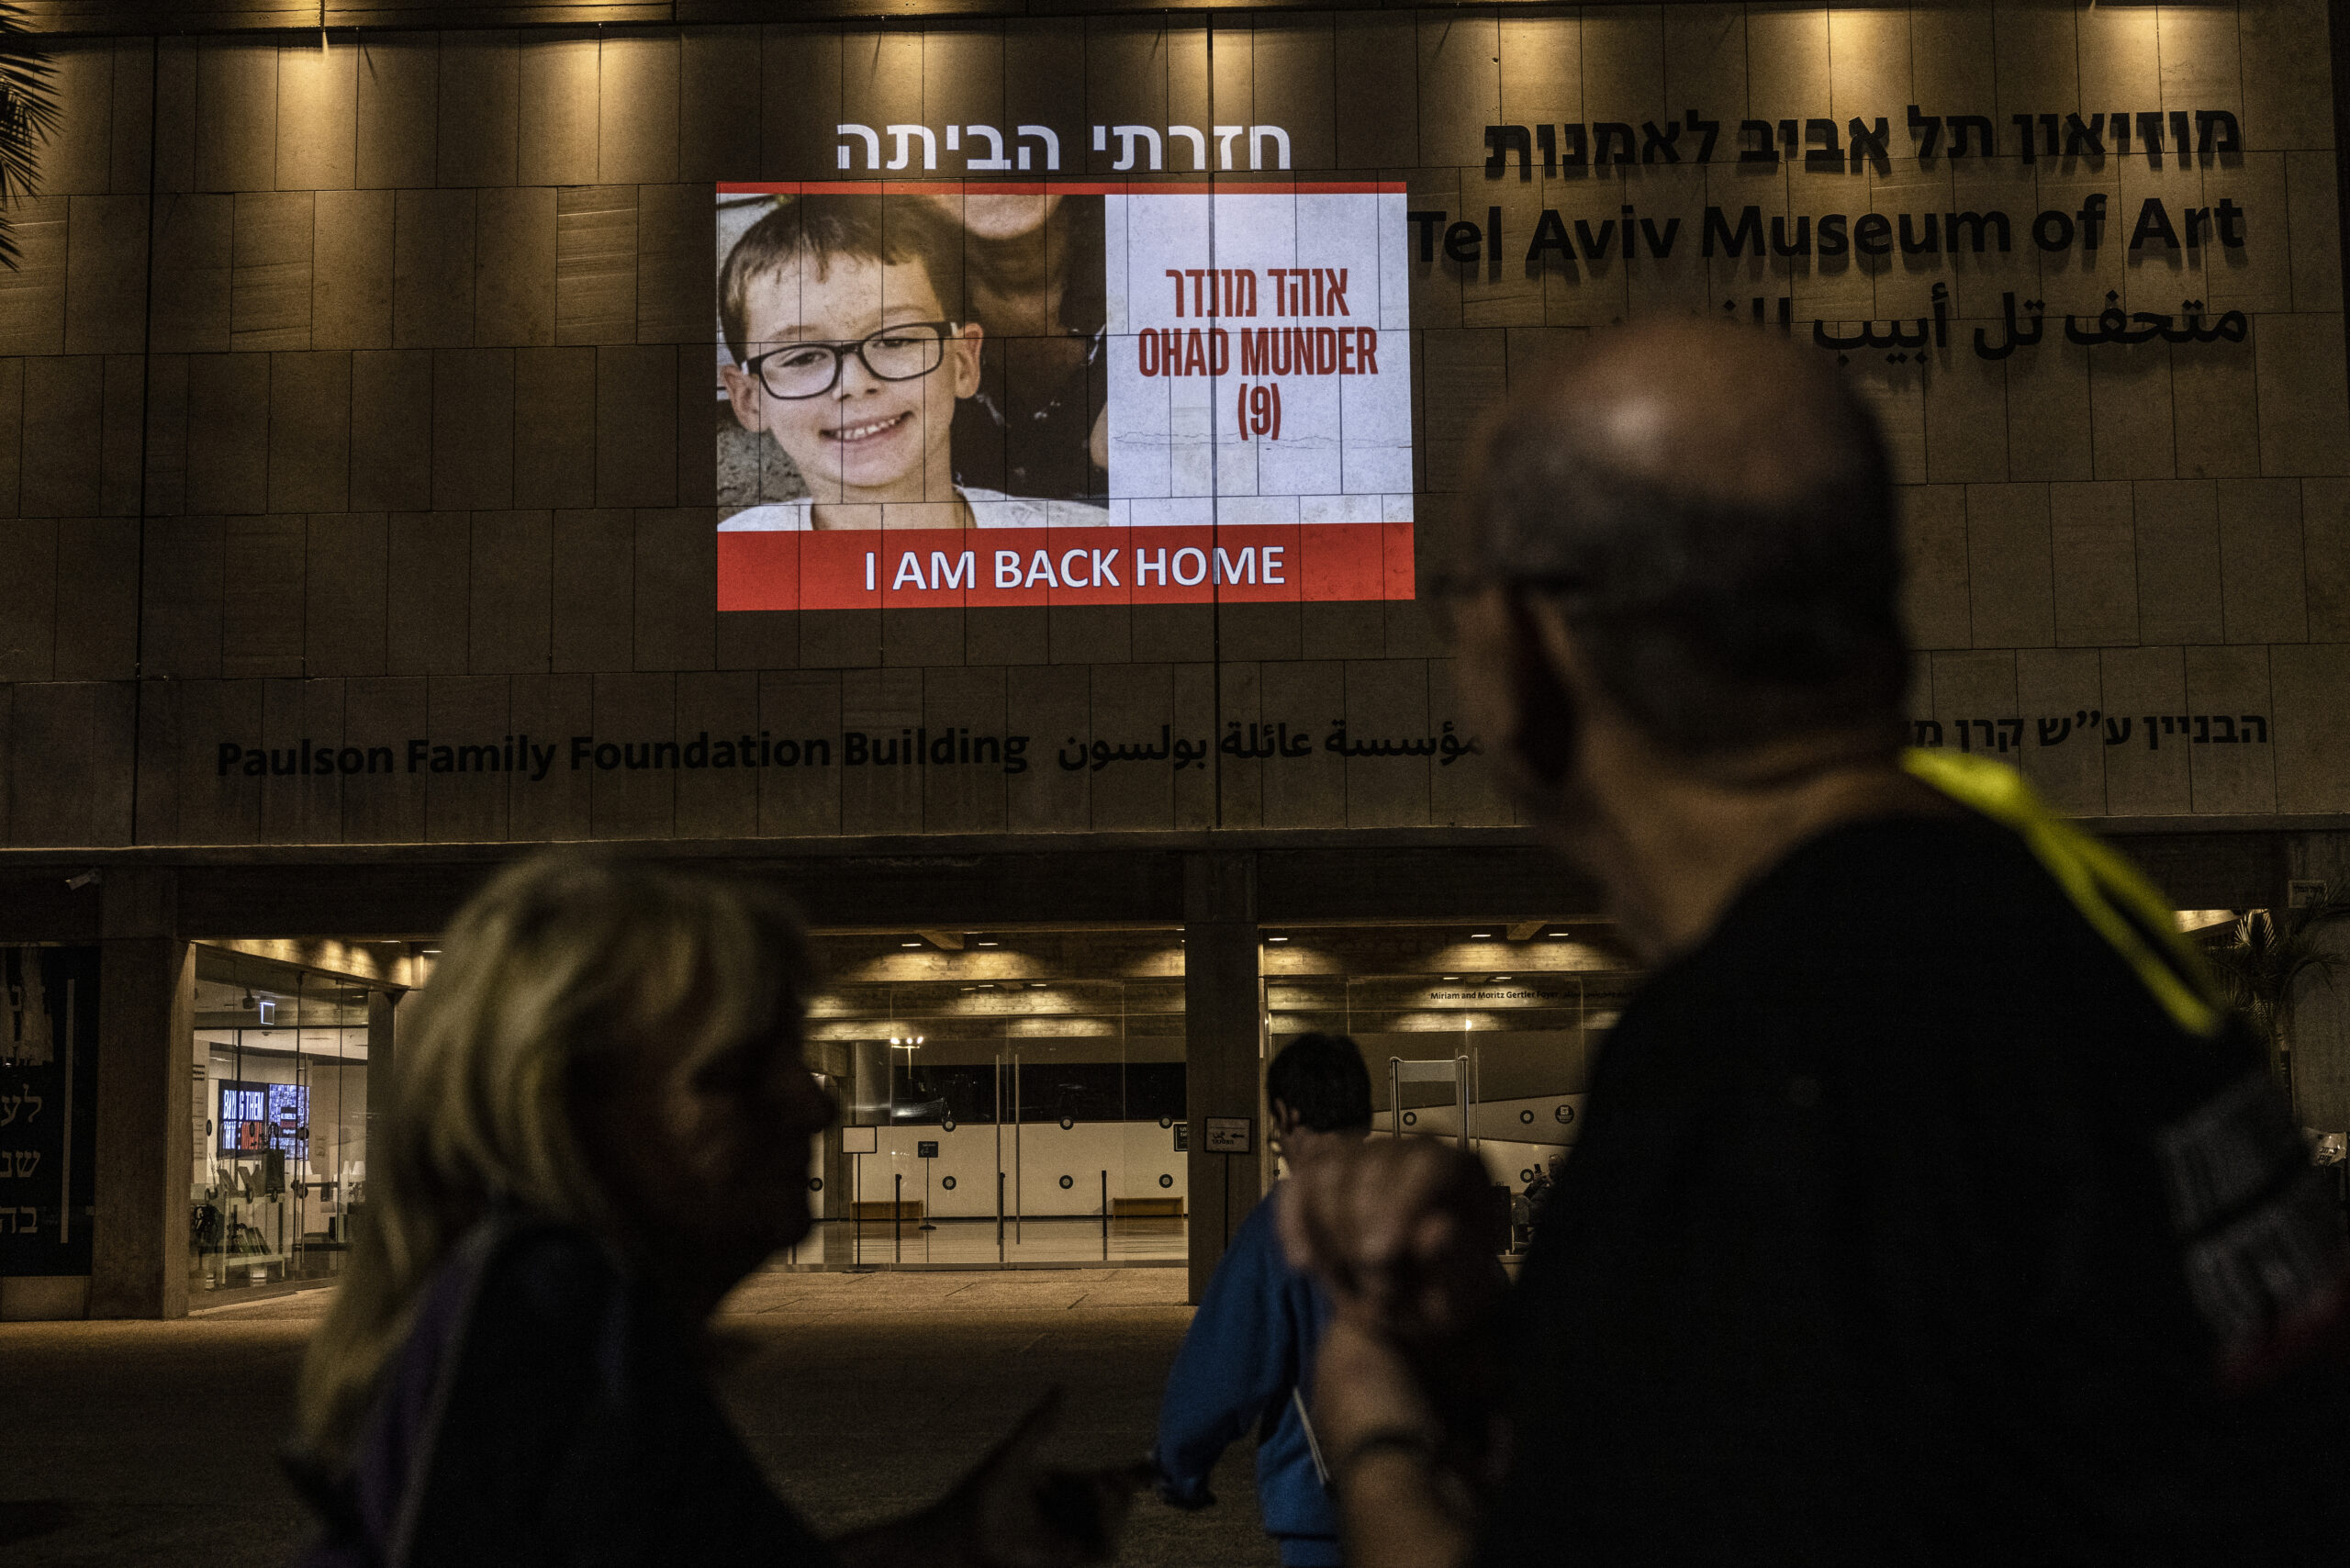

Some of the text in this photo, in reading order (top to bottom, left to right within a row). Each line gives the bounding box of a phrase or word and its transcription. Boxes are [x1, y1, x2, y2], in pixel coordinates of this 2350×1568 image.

[836, 124, 1292, 171] חזרתי הביתה
[1484, 105, 2240, 169] מוזיאון תל אביב לאמנות
[1406, 193, 2245, 263] Tel Aviv Museum of Art
[1165, 268, 1351, 318] אוהד מונדר
[2065, 289, 2247, 344] متحف
[1813, 282, 1949, 366] أبيب
[1973, 291, 2046, 361] تل
[1138, 326, 1379, 377] OHAD MUNDER
[1237, 382, 1282, 442] (9)
[865, 546, 1286, 591] I AM BACK HOME
[218, 727, 1030, 782] Paulson Family Foundation Building
[1058, 723, 1208, 772] بولسون
[1220, 721, 1313, 759] عائلة
[1954, 718, 2025, 754] קרן
[2143, 714, 2267, 750] הבניין
[1430, 991, 1460, 1000] Miriam
[1461, 991, 1476, 1000] and
[1477, 991, 1505, 1000] Moritz
[1506, 991, 1536, 999] Gertler
[245, 1091, 264, 1121] THEM
